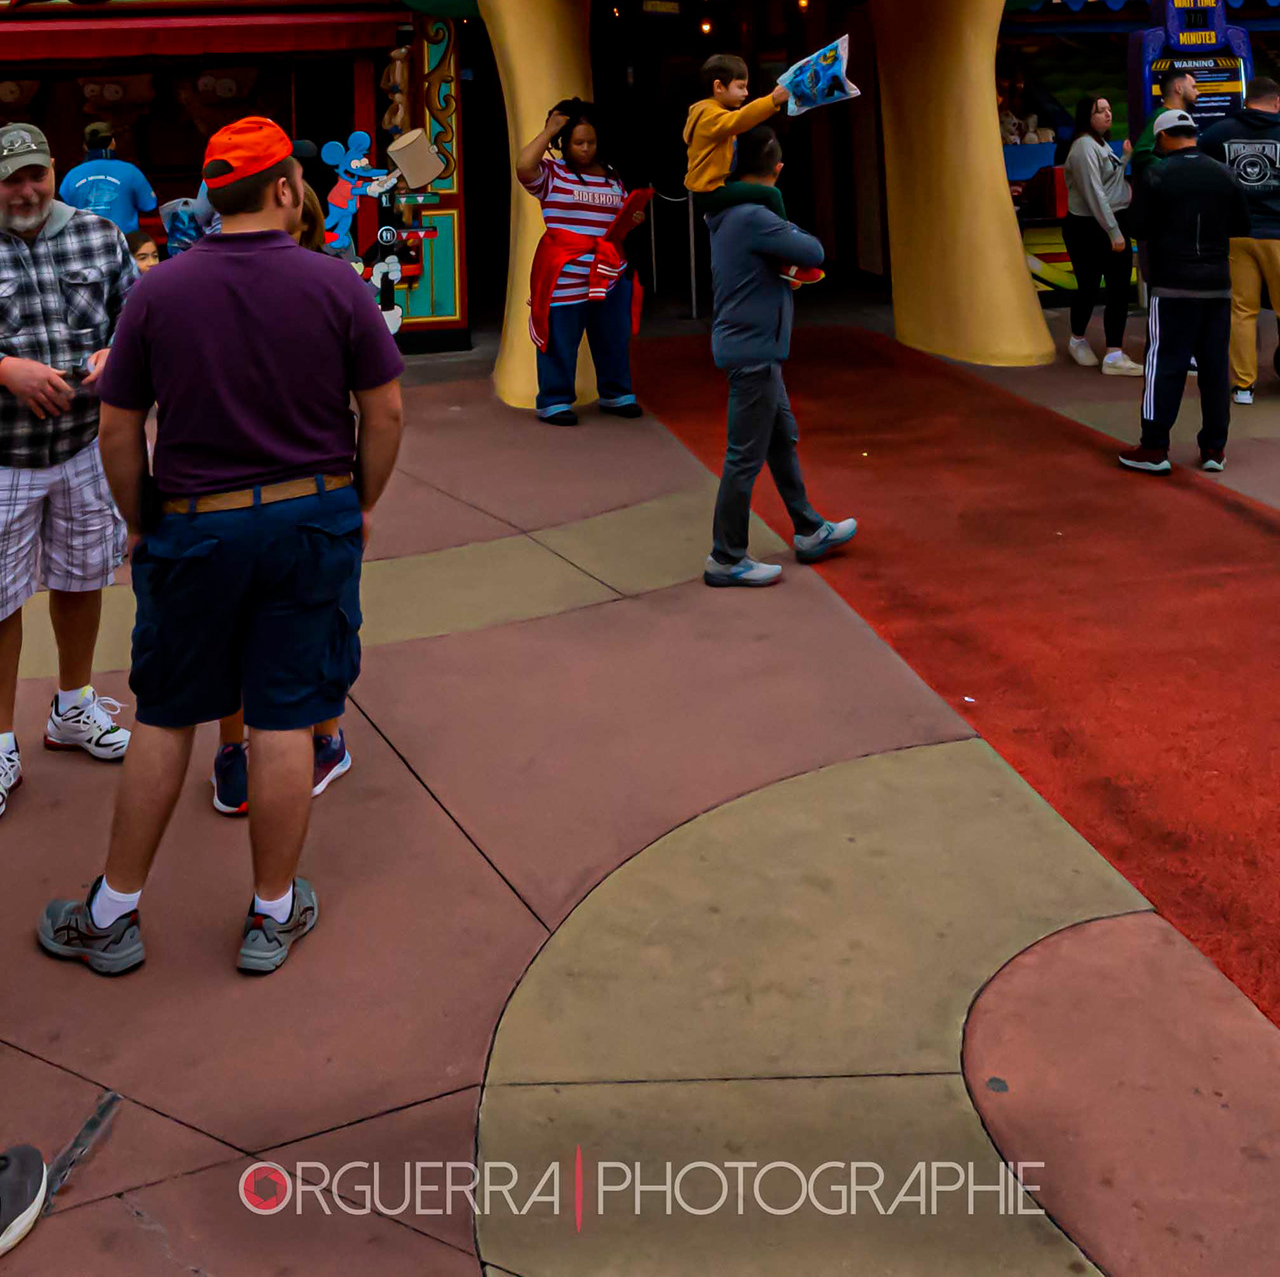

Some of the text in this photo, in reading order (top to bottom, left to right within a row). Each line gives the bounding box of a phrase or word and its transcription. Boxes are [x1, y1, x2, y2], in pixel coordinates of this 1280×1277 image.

[1179, 31, 1217, 45] MINUTES
[1173, 59, 1215, 69] WARNING
[573, 189, 622, 206] SIDESHOW
